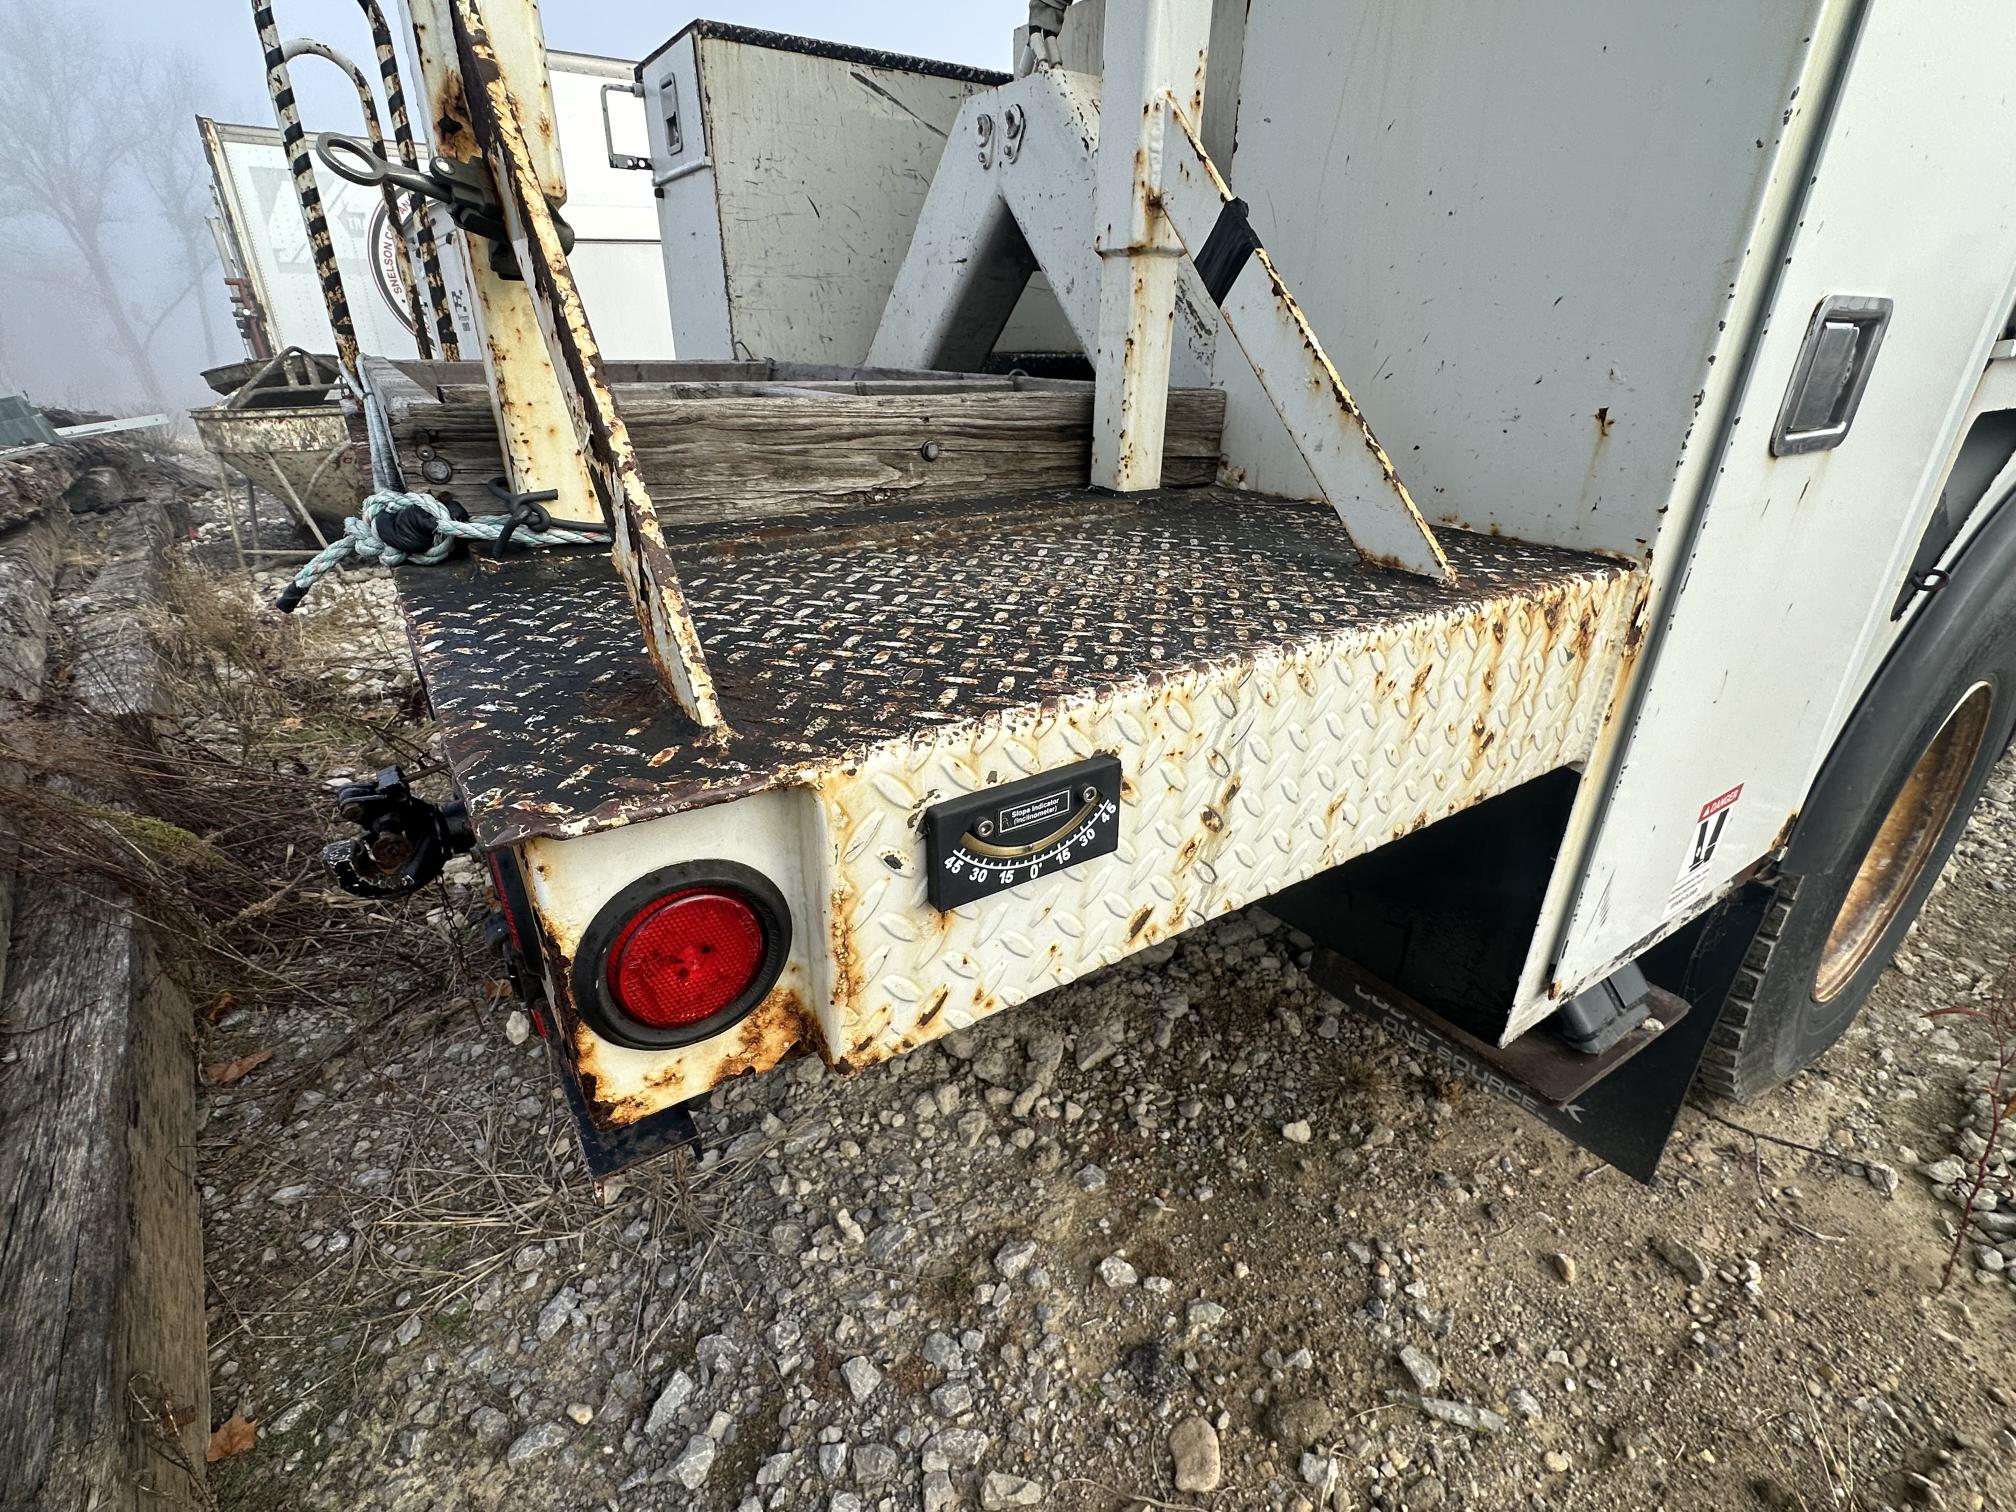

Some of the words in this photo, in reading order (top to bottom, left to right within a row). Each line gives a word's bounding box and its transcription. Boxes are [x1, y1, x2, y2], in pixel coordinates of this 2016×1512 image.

[383, 242, 403, 295] SNELSON
[1011, 808, 1031, 818] Slope
[1031, 798, 1060, 811] Indicator
[1013, 805, 1058, 825] (Inclinometer)
[1709, 789, 1739, 811] DANGER
[944, 855, 965, 874] 45
[969, 869, 988, 883] 30
[999, 869, 1015, 885] 15
[1055, 848, 1071, 865] 15
[1079, 828, 1096, 847] 30
[1100, 802, 1117, 823] 45
[1382, 1016, 1433, 1052] ONE
[1436, 1048, 1539, 1112] SOURCE
